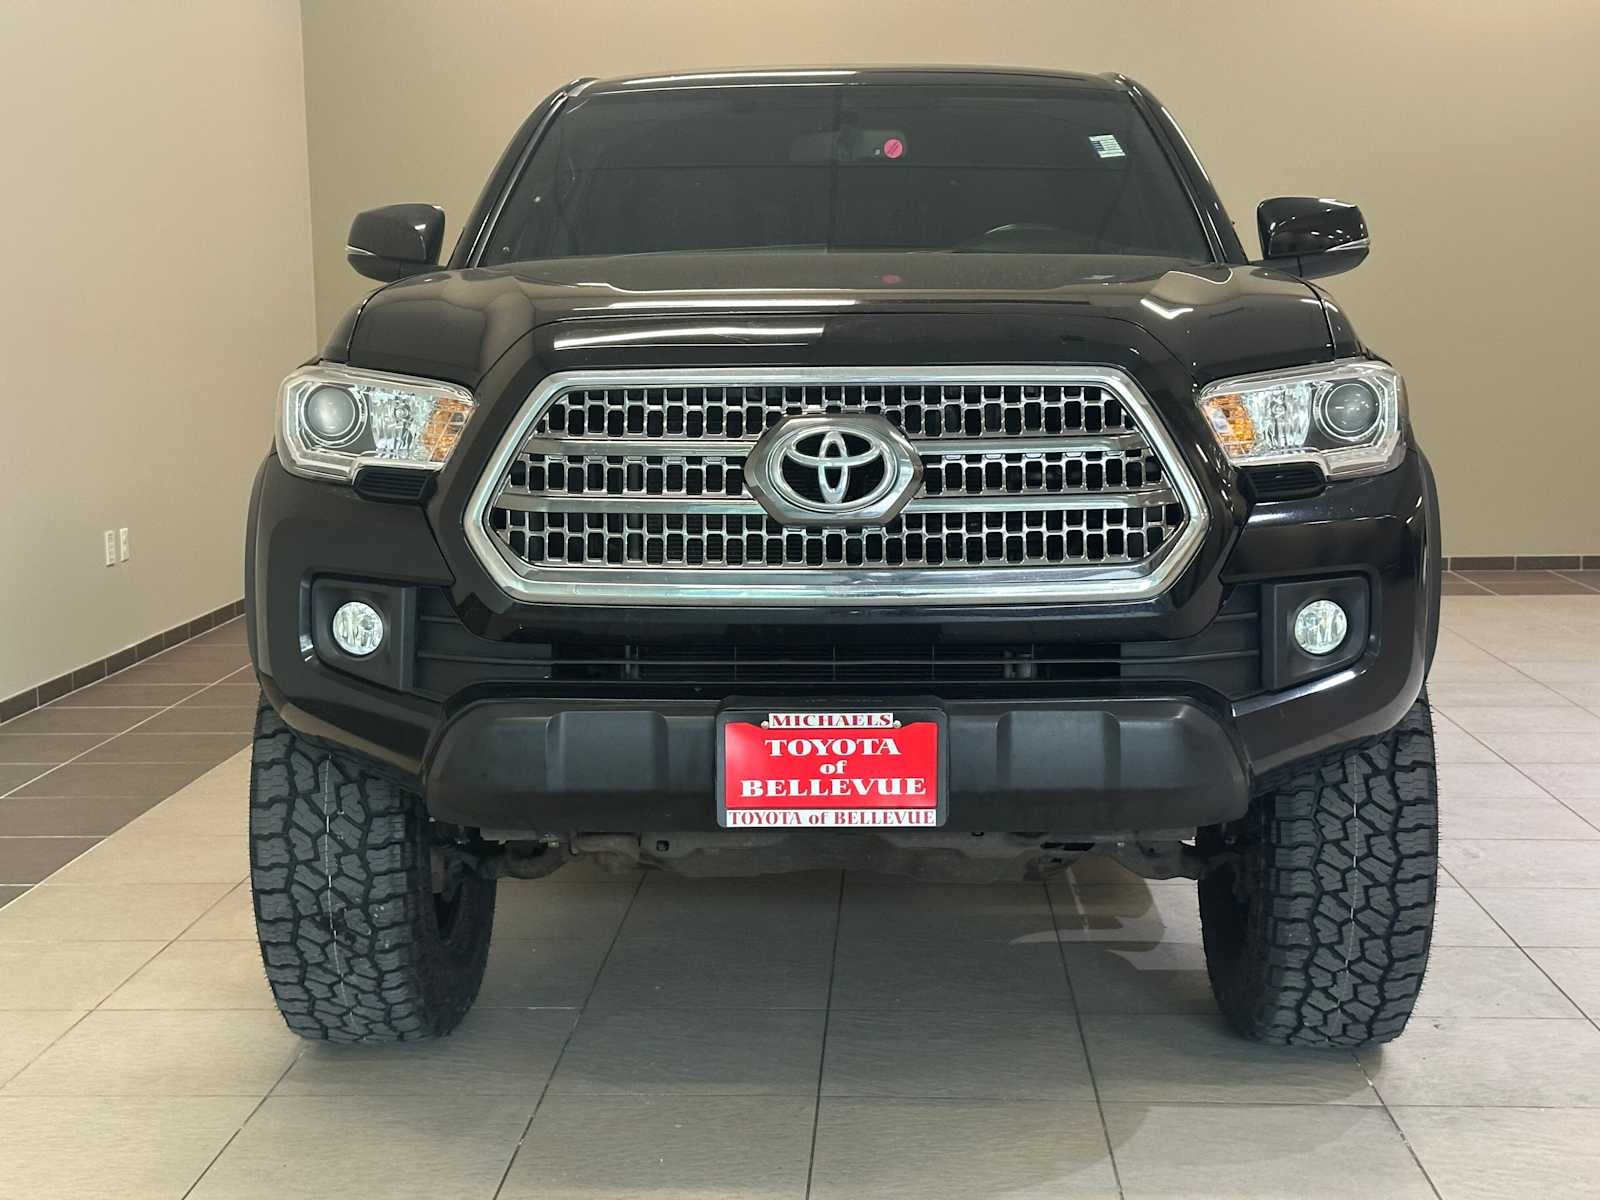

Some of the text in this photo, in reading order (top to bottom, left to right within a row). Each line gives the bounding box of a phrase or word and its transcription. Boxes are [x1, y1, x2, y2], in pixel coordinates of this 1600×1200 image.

[771, 714, 892, 727] MICHAELS
[764, 738, 902, 756] TOYOTA
[819, 760, 847, 775] of
[740, 777, 927, 797] BELLEVUE
[729, 811, 934, 825] TOYOTA of BELLEVUE
